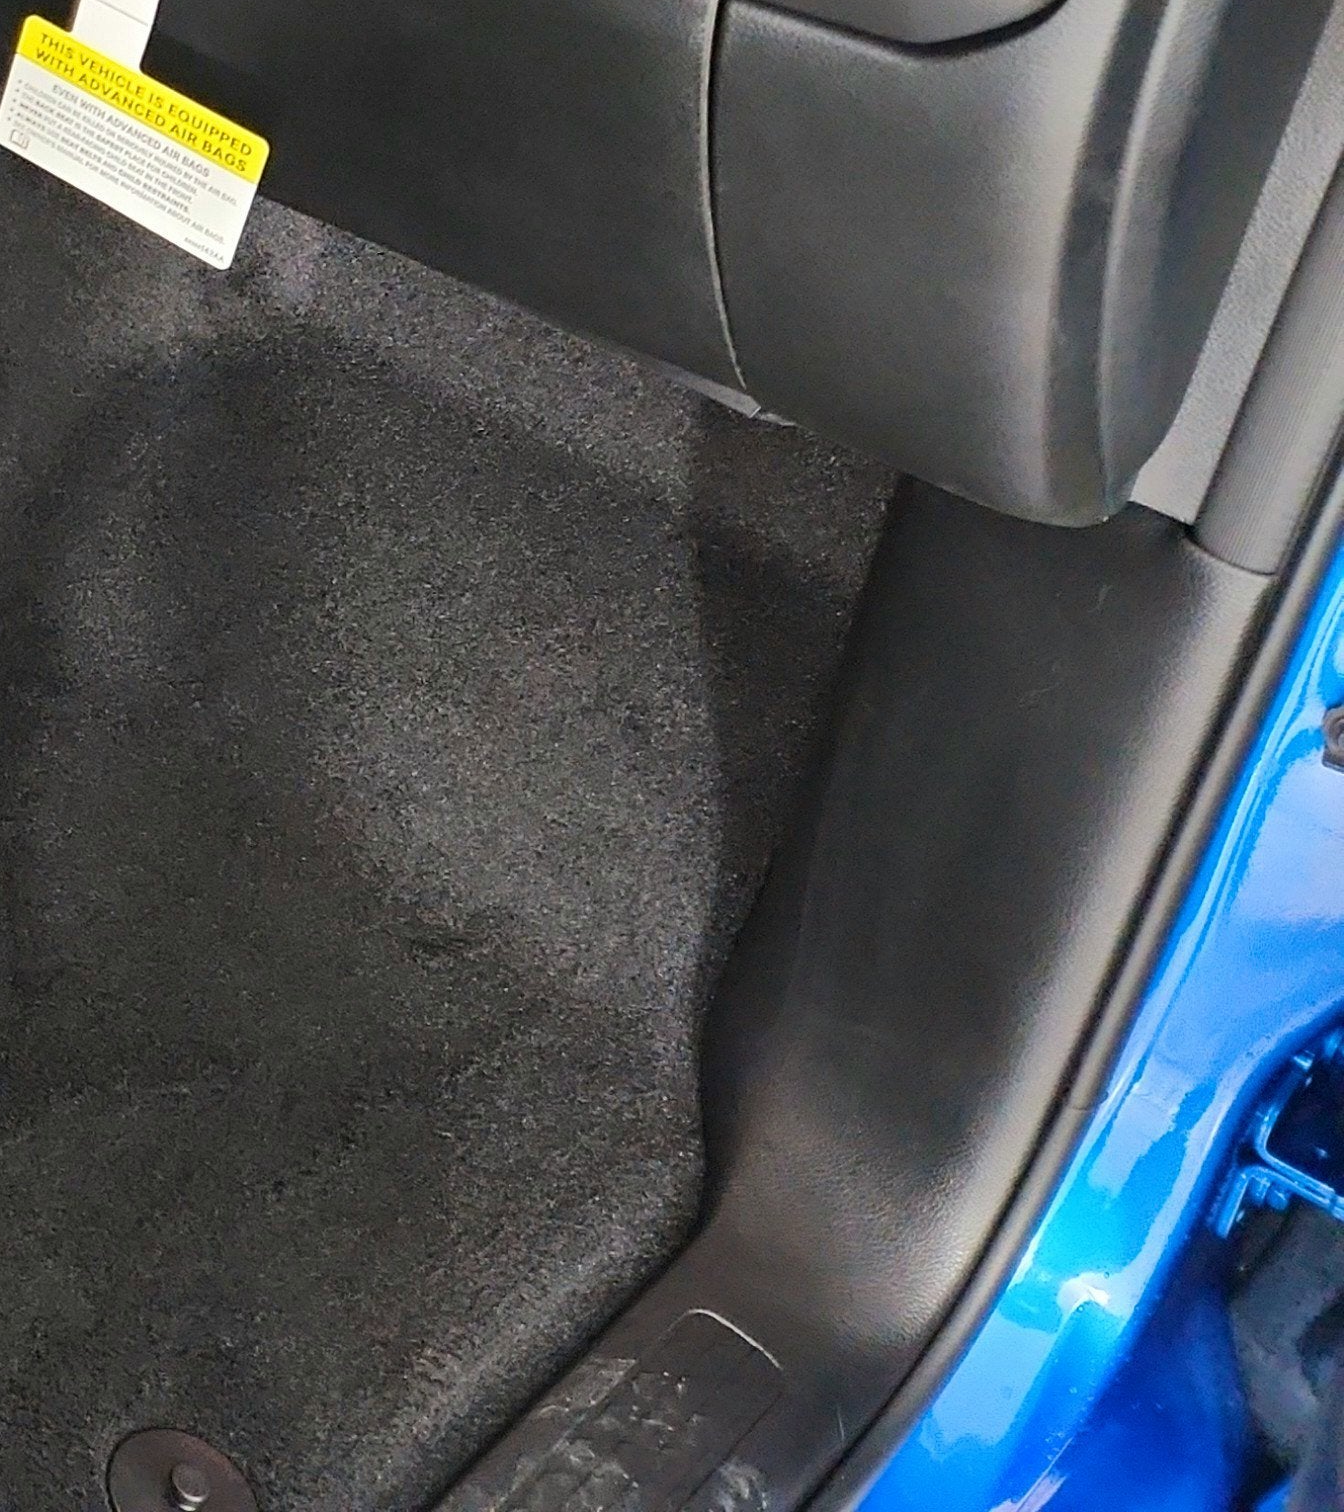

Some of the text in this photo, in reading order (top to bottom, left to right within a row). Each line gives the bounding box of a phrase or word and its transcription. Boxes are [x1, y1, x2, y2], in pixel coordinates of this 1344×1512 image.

[35, 47, 247, 173] WITH ADVANCED AIR BAGS
[39, 32, 253, 158] THIS VEHICLE IS EQUIPPED
[51, 83, 210, 178] EVEN WITH ADVANCED AIR BAGS
